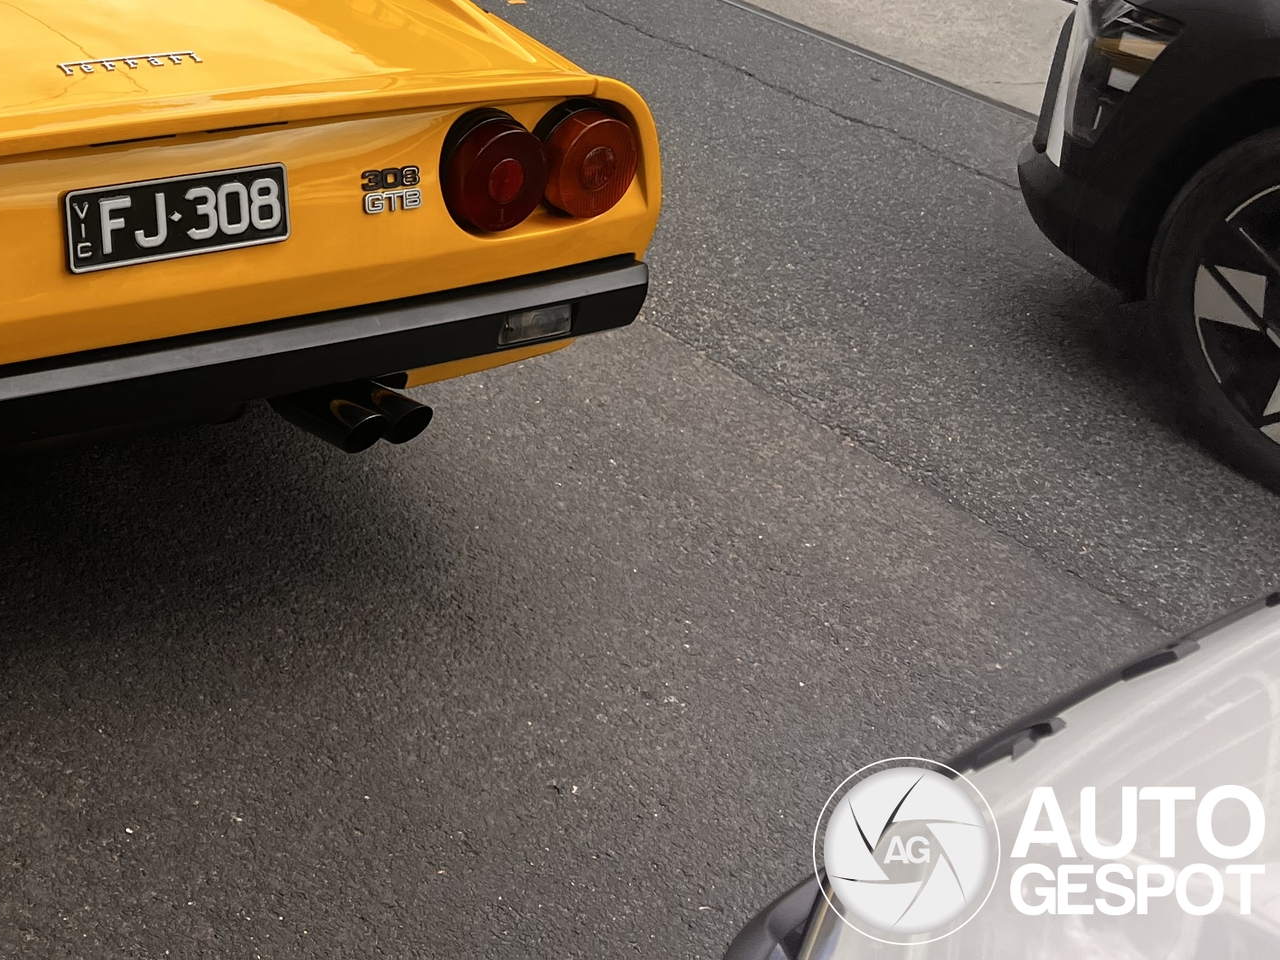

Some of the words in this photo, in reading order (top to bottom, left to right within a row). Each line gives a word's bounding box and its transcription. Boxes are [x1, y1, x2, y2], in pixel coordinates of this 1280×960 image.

[361, 165, 421, 192] 308
[364, 188, 423, 214] GTB
[72, 201, 93, 259] VIC
